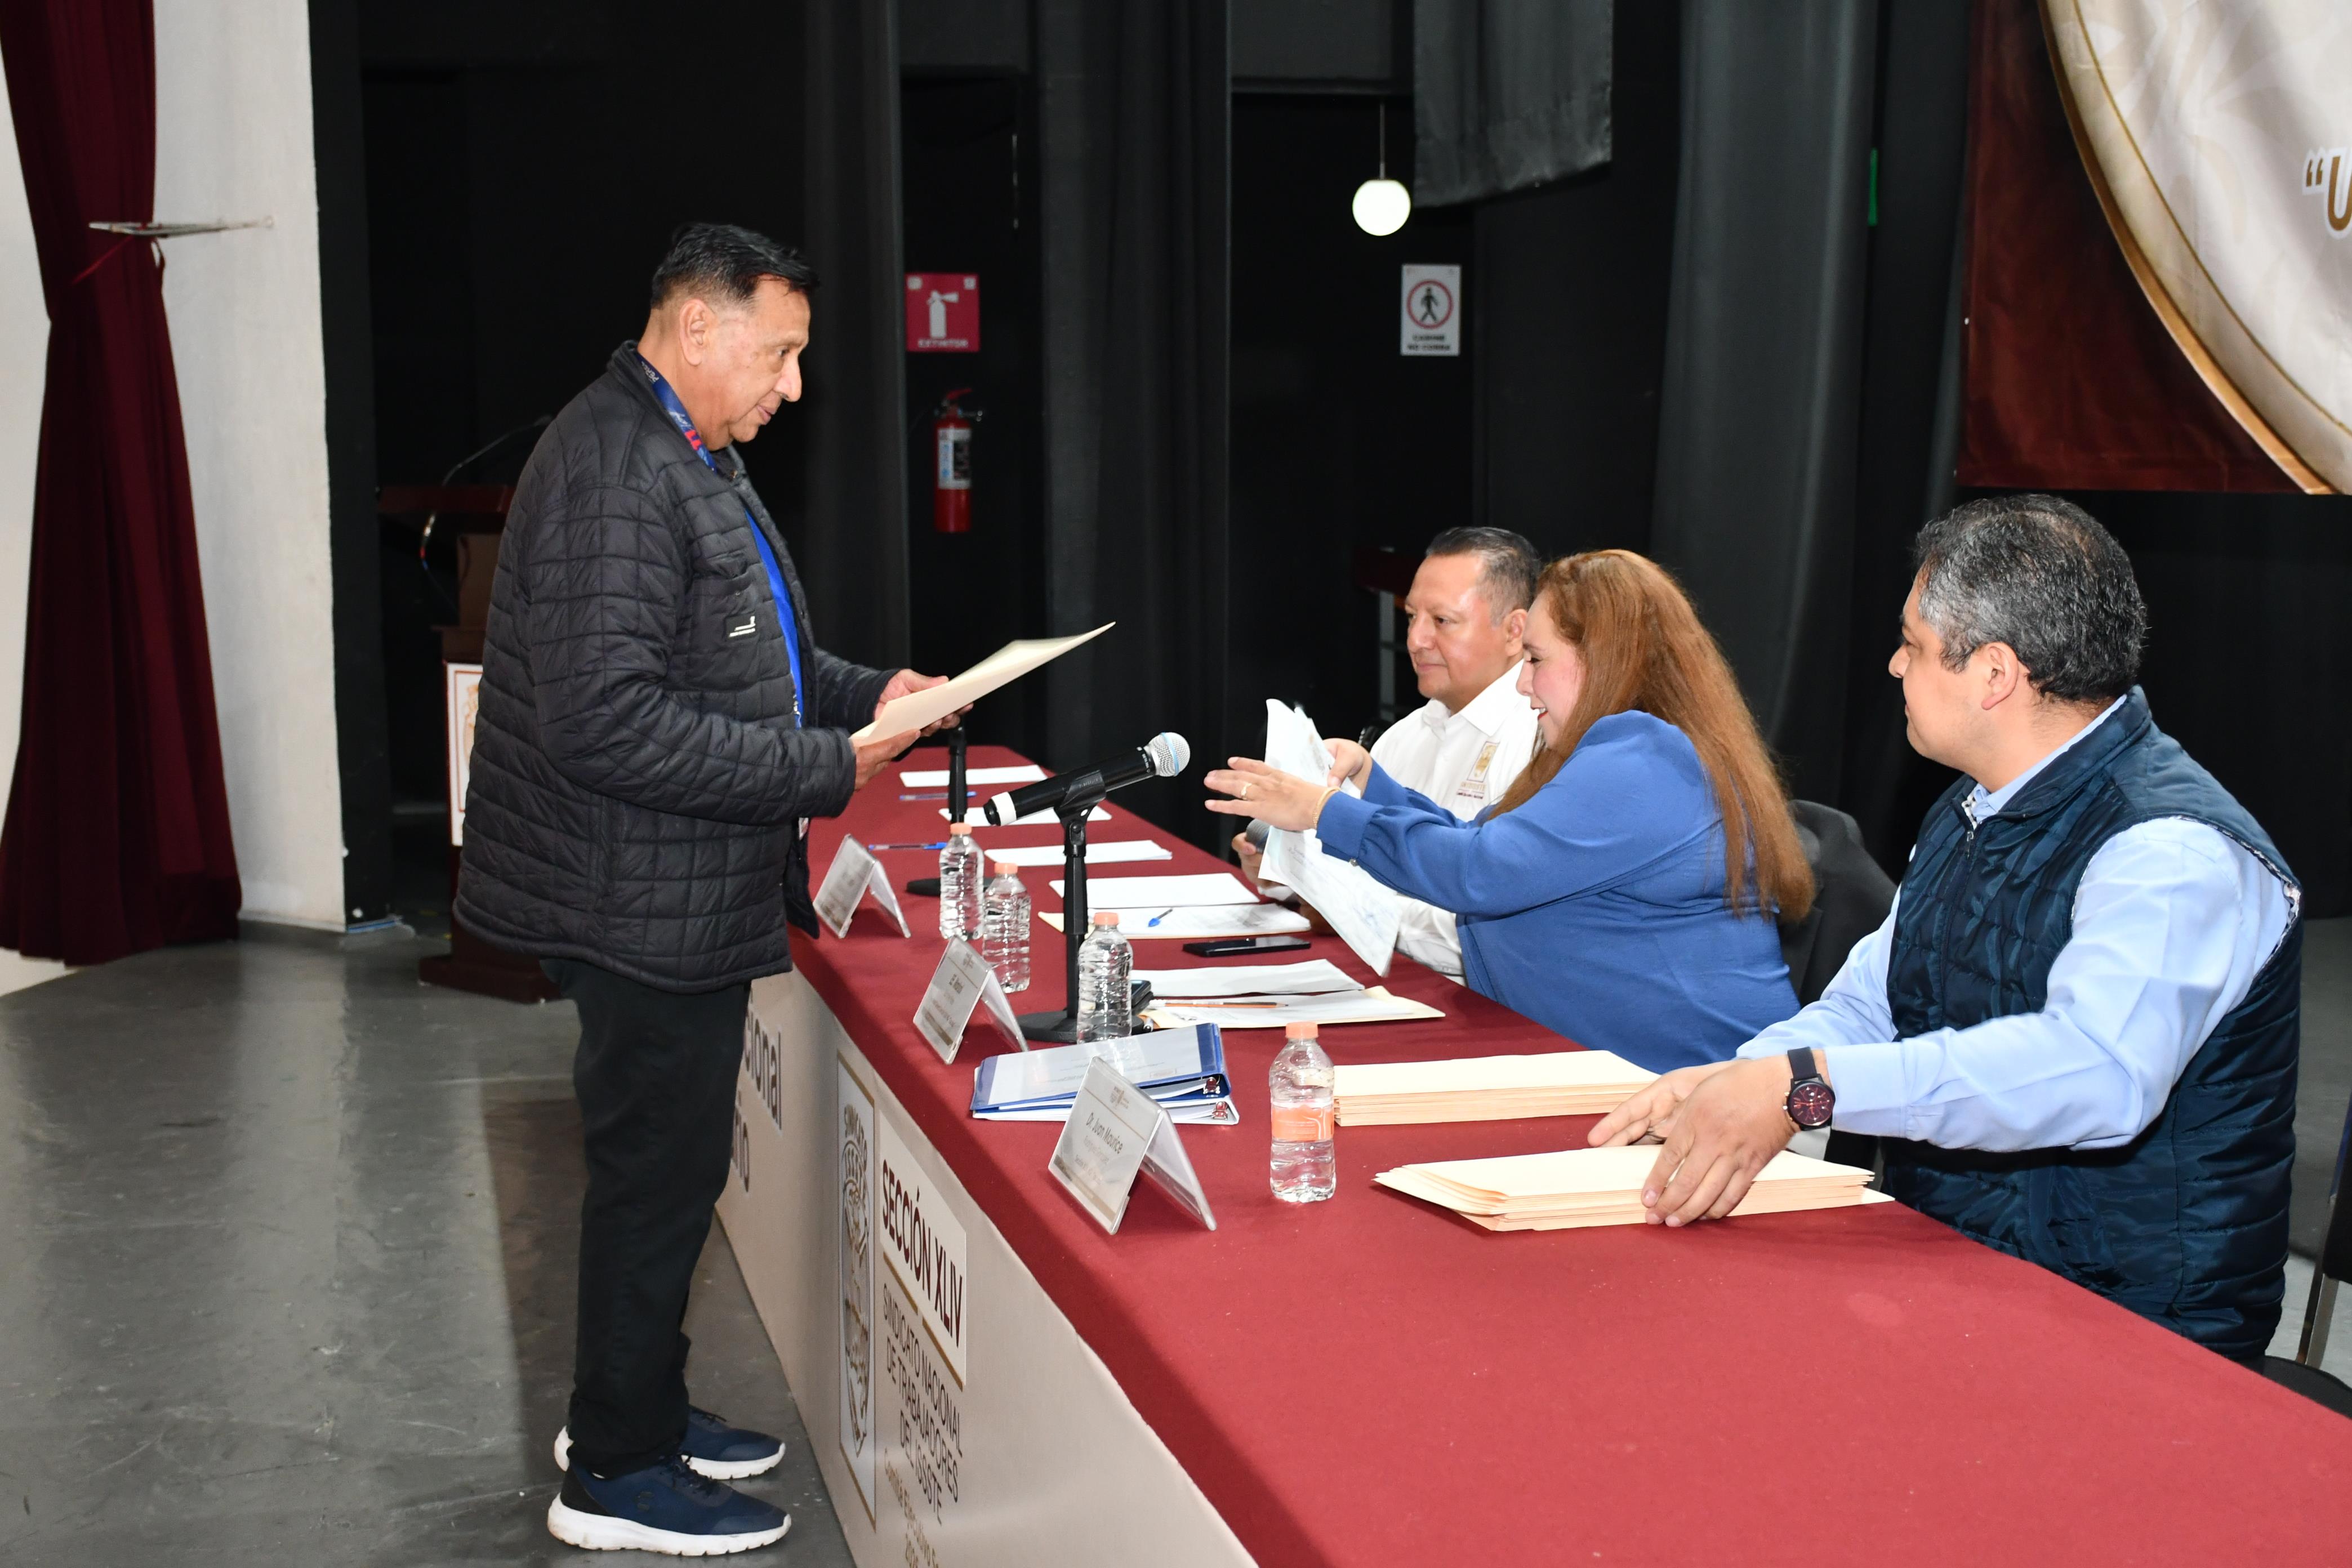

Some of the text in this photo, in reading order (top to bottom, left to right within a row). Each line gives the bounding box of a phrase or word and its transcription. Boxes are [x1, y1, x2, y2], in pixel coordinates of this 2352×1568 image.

[1086, 1112, 1094, 1129] Dr.
[1092, 1118, 1105, 1138] Juan
[1103, 1127, 1123, 1155] Maurice
[882, 1158, 963, 1348] SECCIÓN XLIV
[883, 1282, 963, 1458] SINDICATO NACIONAL
[887, 1335, 958, 1503] DE TRABAJADORES
[900, 1410, 942, 1526] DEL ISSSTE
